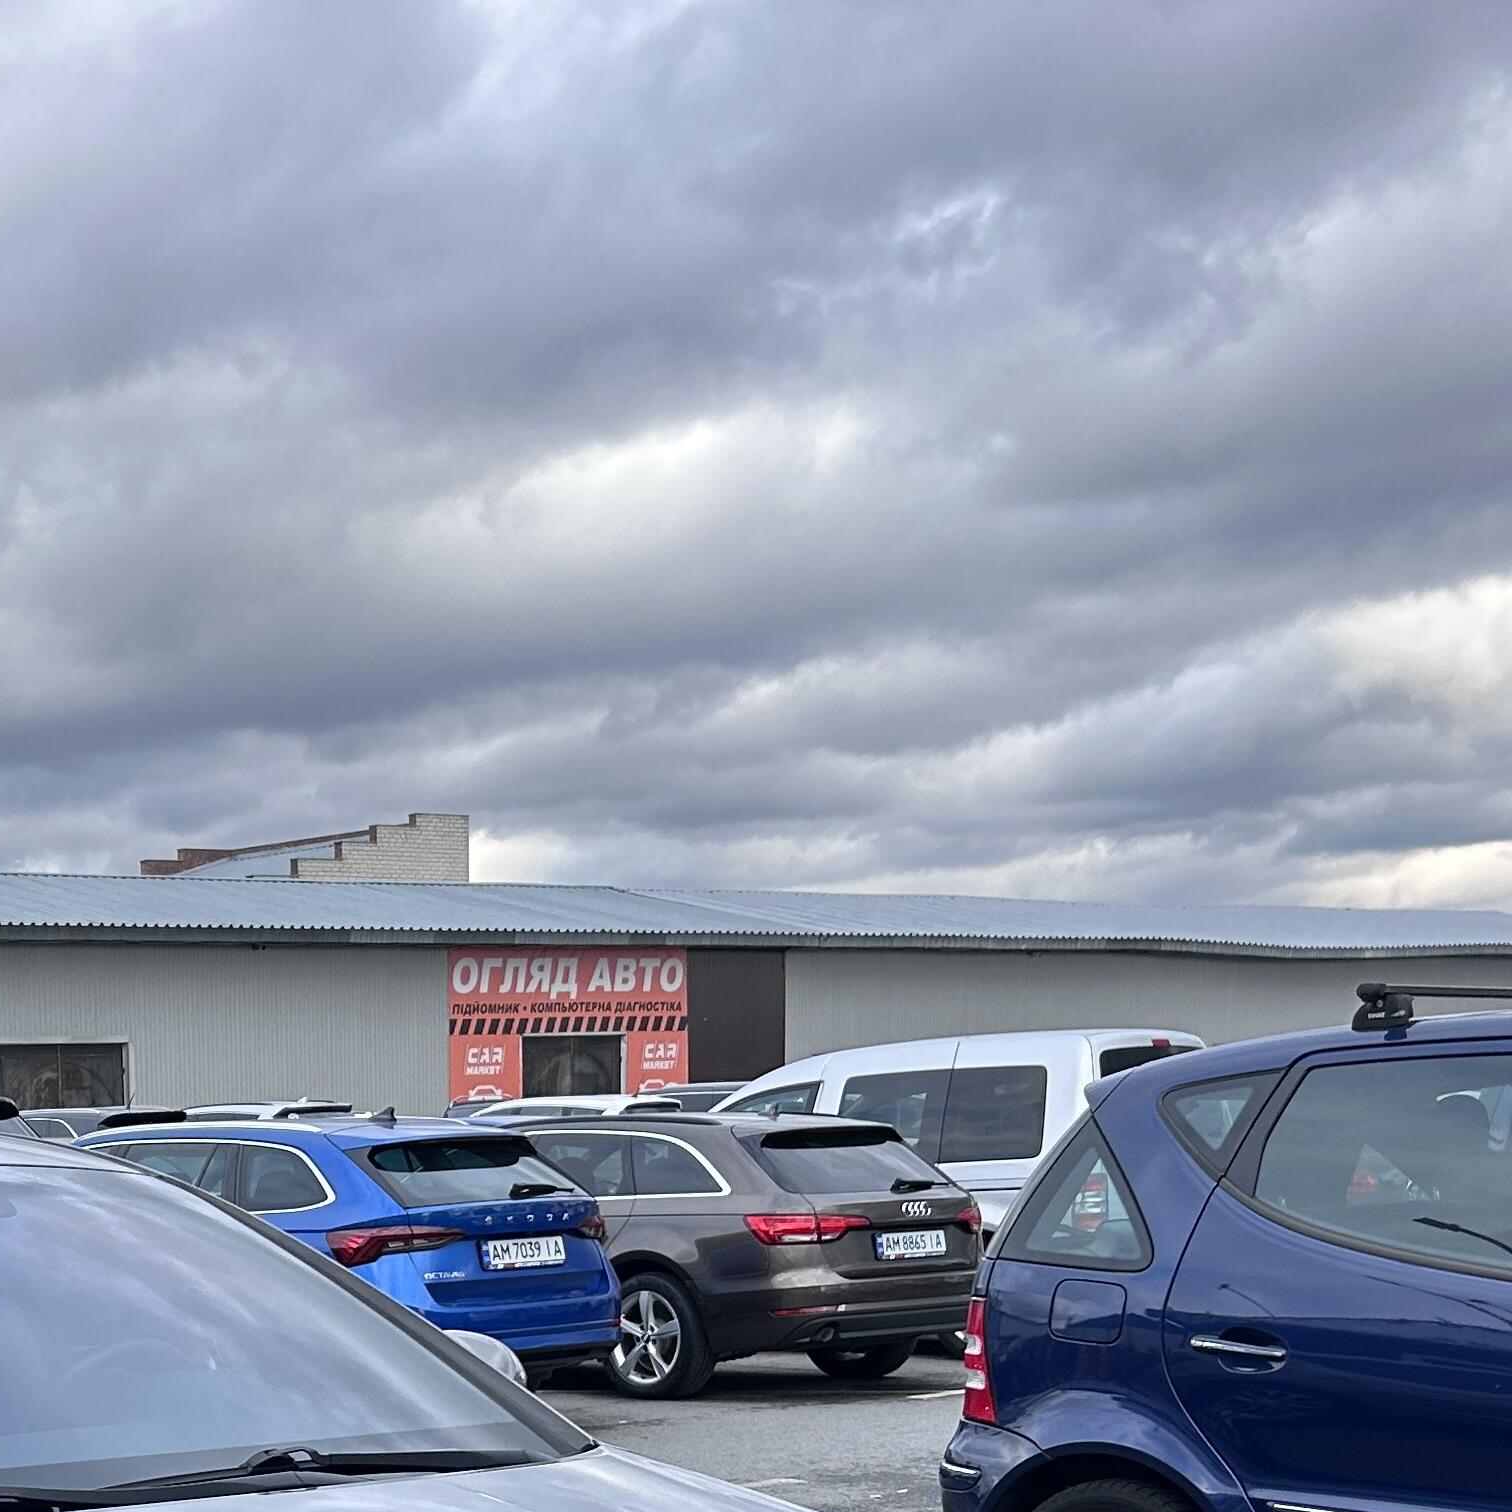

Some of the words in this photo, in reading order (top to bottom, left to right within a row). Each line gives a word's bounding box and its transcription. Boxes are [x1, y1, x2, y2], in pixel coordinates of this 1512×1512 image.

[452, 957, 579, 1000] ОГЛЯД
[587, 956, 684, 993] АВТО
[452, 1001, 519, 1016] ПІДЙОМНИК
[467, 1045, 504, 1064] CAR
[643, 1043, 677, 1059] CAR
[492, 1244, 512, 1261] AM
[513, 1242, 541, 1259] 7039
[546, 1240, 562, 1257] IA
[886, 1237, 900, 1252] AM
[902, 1235, 927, 1250] 8865
[929, 1234, 943, 1249] IA
